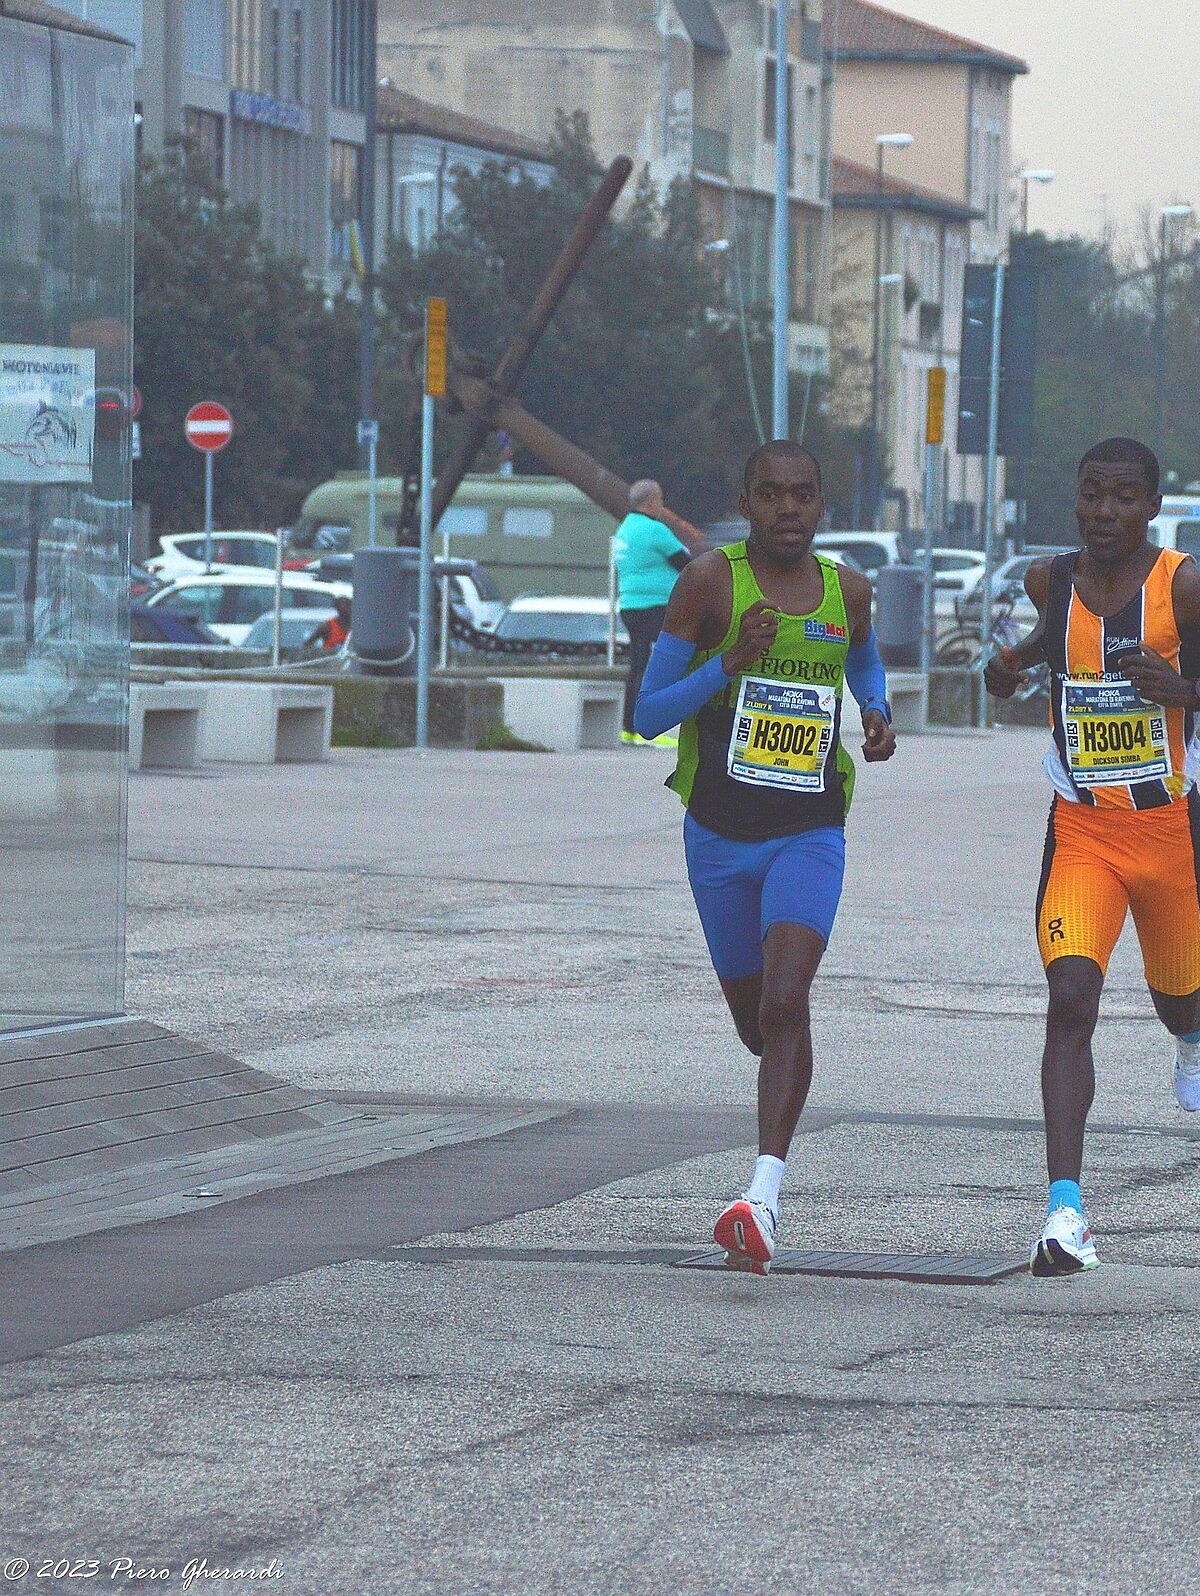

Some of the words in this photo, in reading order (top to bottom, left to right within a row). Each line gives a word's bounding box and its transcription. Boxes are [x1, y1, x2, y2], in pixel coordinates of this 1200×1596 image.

[804, 619, 845, 636] BigMat
[782, 690, 803, 698] HOKA
[752, 719, 817, 756] H3002
[1082, 720, 1147, 752] H3004
[773, 757, 789, 767] JOHN
[1093, 756, 1120, 766] DICKSON
[1120, 754, 1141, 764] SIMBA
